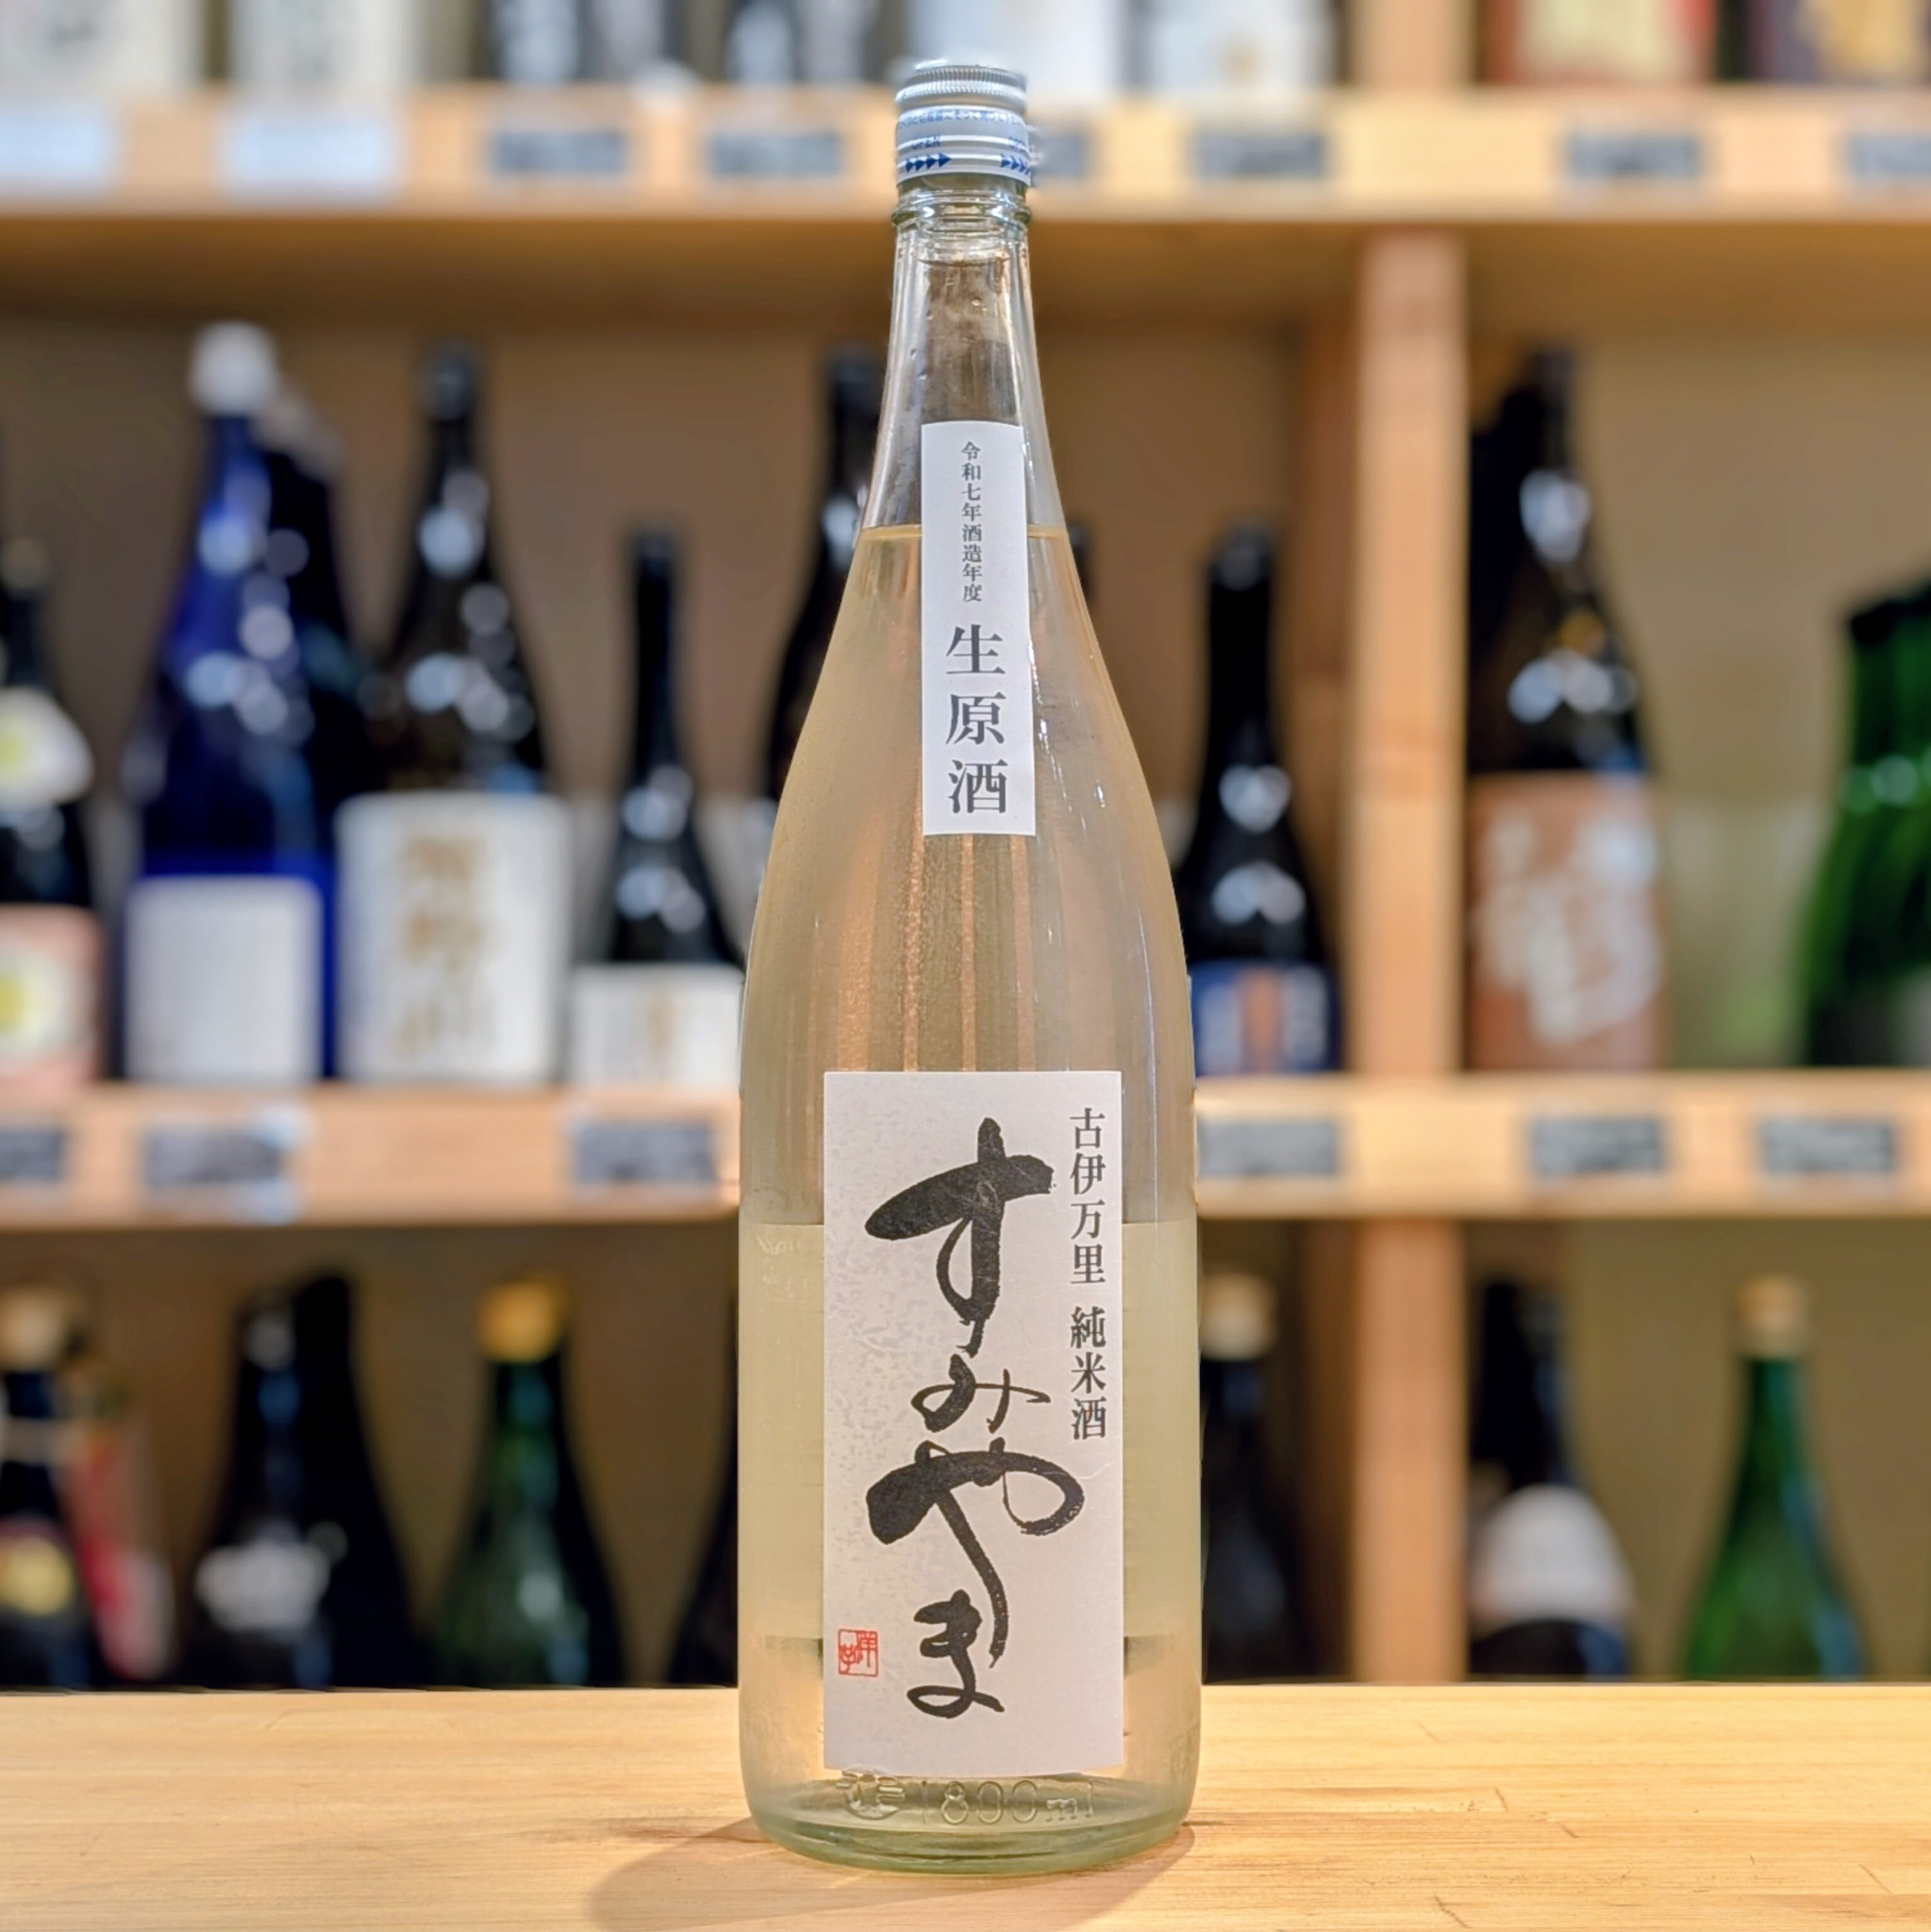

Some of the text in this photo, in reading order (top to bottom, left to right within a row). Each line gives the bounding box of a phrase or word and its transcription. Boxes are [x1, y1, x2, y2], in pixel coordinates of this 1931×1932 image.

[961, 441, 983, 602] 令和七年酒造年度
[946, 624, 1009, 814] 生原酒
[1070, 1107, 1107, 1441] 古伊万里 純米酒
[865, 1117, 1085, 1719] すみやま
